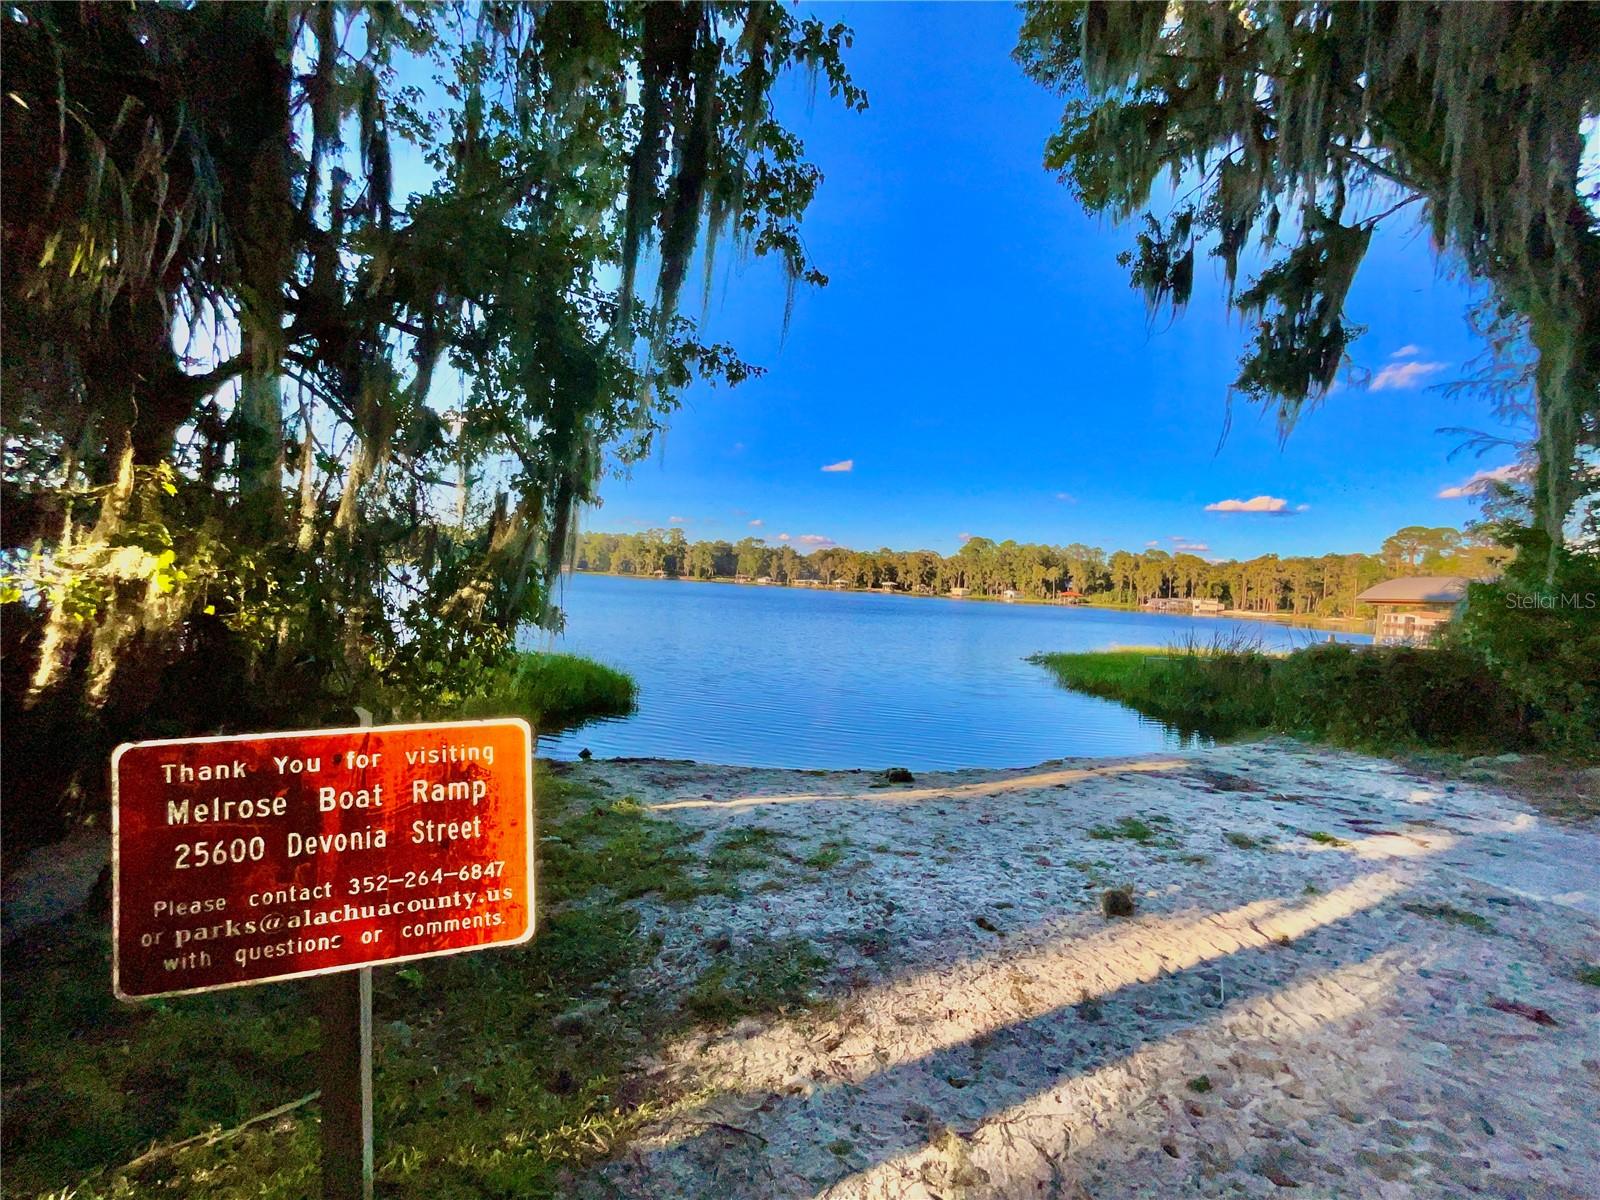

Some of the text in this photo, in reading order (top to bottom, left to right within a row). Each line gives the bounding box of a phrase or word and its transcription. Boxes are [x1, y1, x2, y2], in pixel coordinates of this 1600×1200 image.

[161, 744, 495, 784] Thank You for visiting
[167, 779, 487, 826] Melrose Boat Ramp
[174, 816, 481, 870] 25600 Devonia Street
[141, 886, 513, 948] or parks@alachuacounty.us
[153, 861, 506, 918] Please contact 352-264-6847
[163, 950, 212, 971] with
[361, 929, 383, 944] or
[402, 911, 506, 938] comments.
